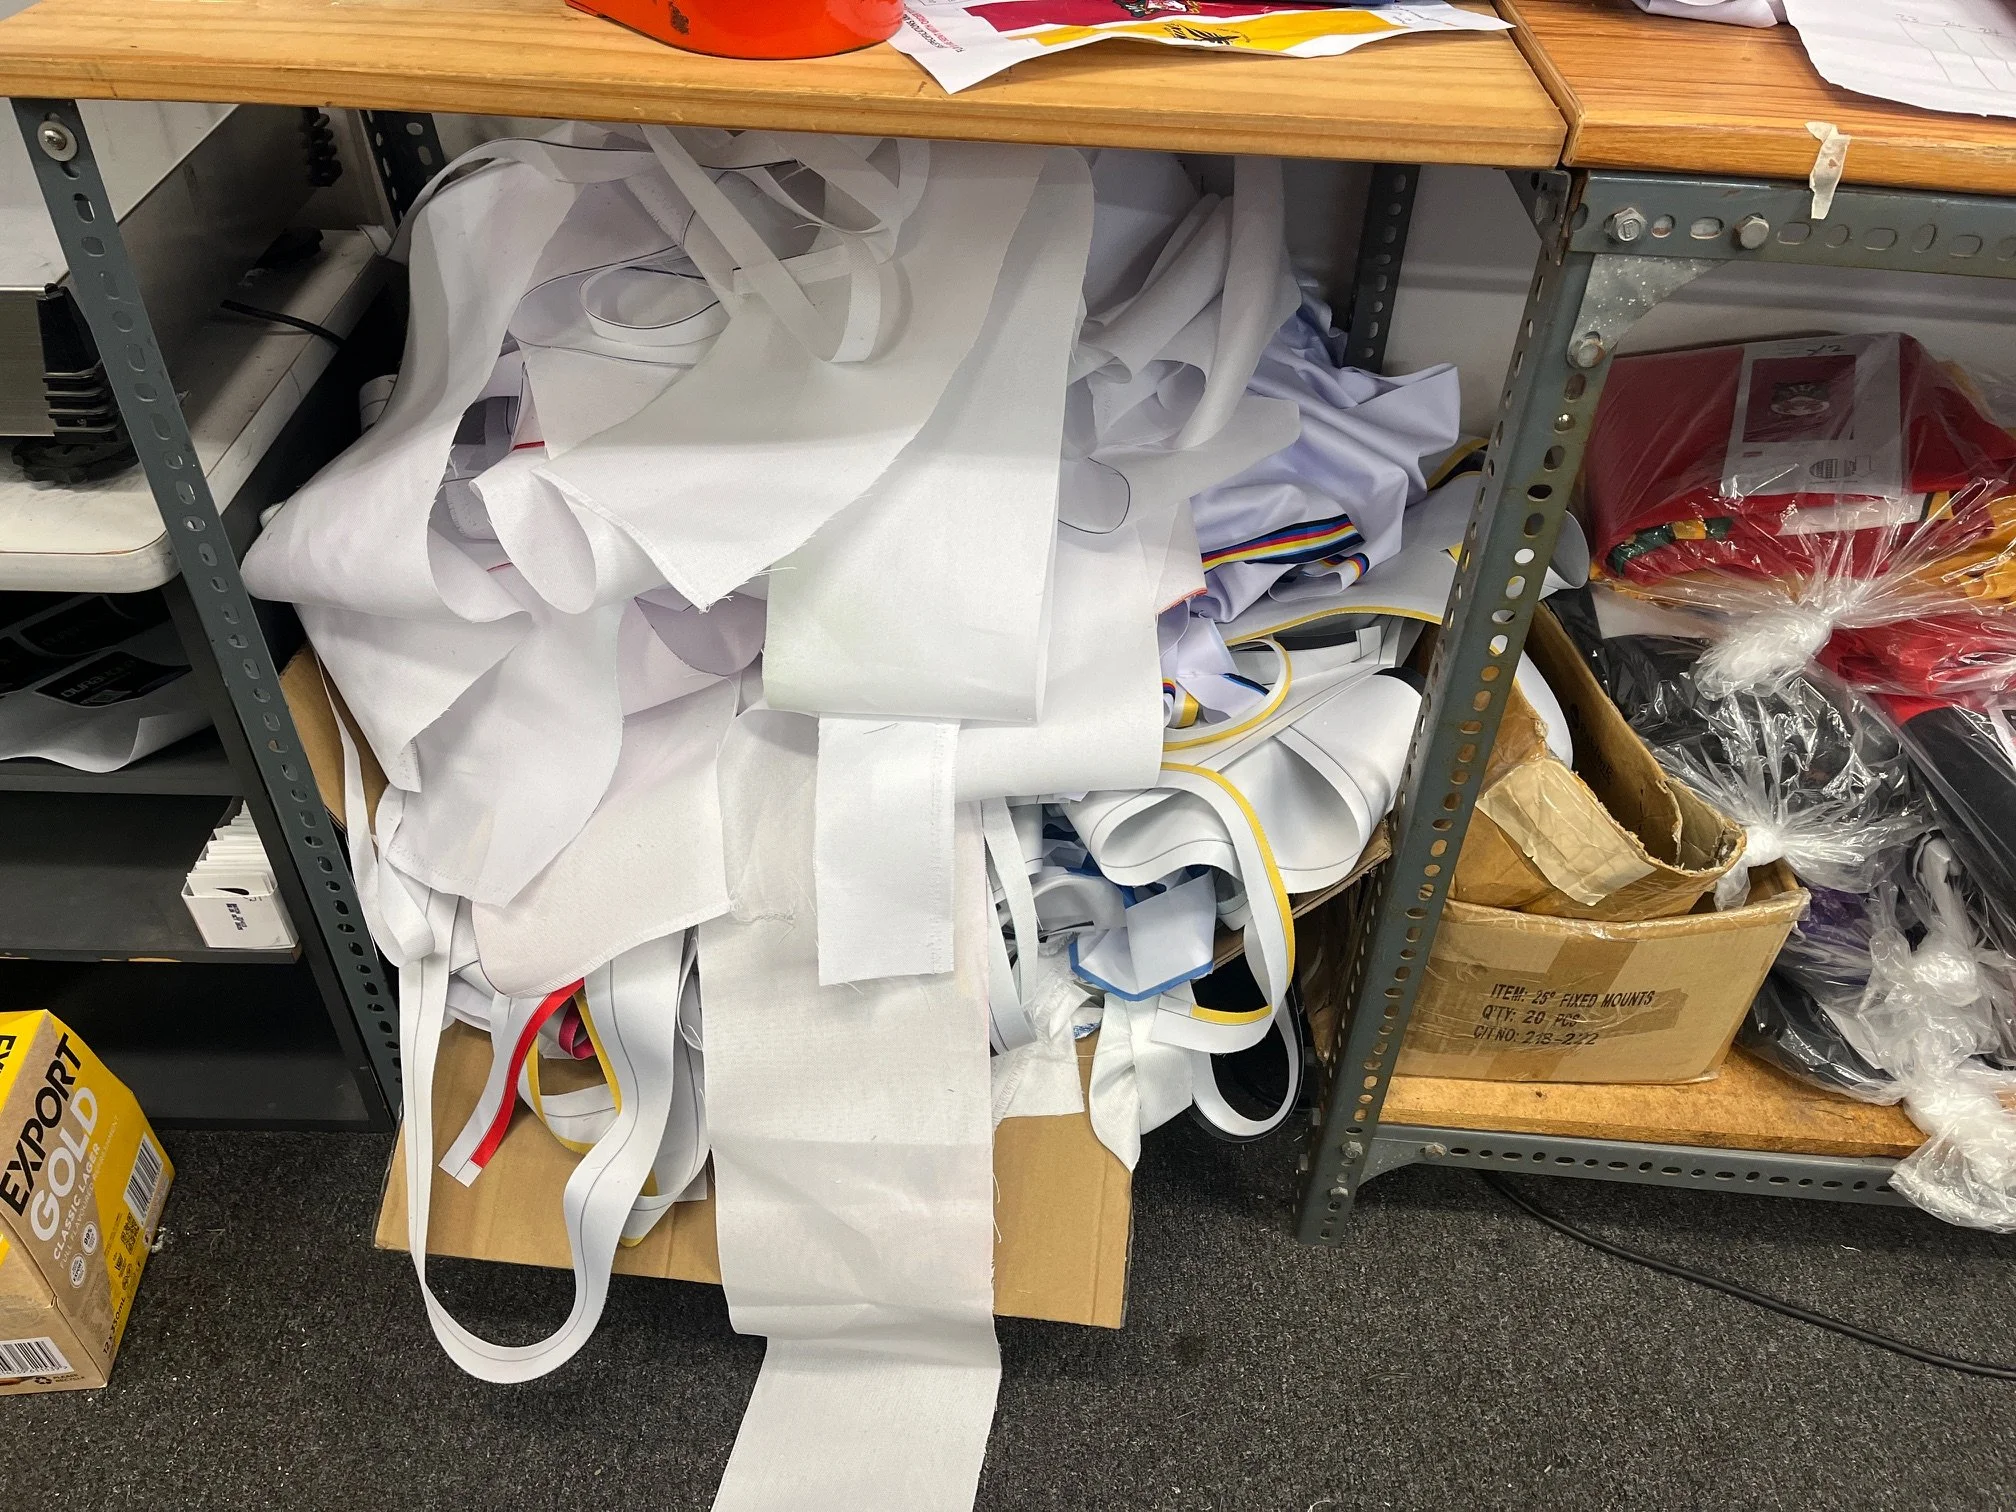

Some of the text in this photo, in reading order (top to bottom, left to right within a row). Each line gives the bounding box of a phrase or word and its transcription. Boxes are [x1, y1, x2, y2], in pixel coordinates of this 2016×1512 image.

[1482, 1004, 1516, 1022] Q'TY:
[1522, 1010, 1546, 1025] 20
[1490, 983, 1528, 1002] ITEM:
[1559, 992, 1599, 1008] FIXED
[1600, 990, 1656, 1009] MOUNTS
[0, 1032, 81, 1216] EXPORT
[31, 1087, 98, 1241] GOLD
[53, 1143, 101, 1260] CLASSIC LAGER
